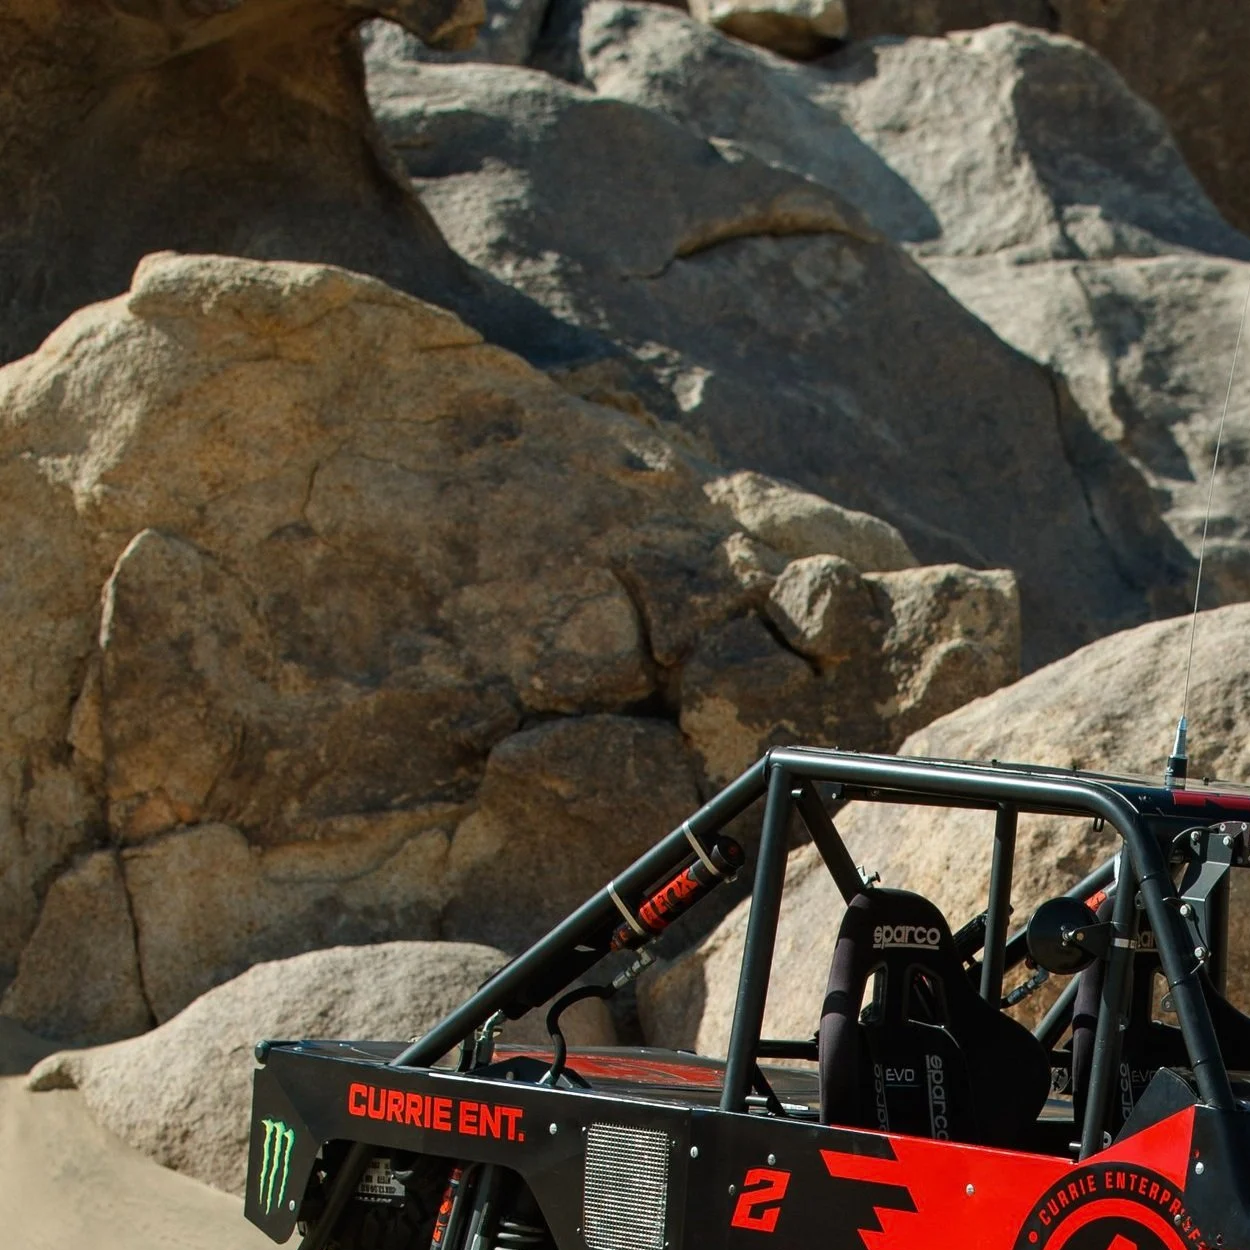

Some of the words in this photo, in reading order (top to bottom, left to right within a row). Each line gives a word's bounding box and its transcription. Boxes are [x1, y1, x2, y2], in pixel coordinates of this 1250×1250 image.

[873, 925, 941, 949] sparco
[874, 1063, 890, 1132] arco
[885, 1067, 915, 1082] EVO
[349, 1083, 452, 1132] CURRIE
[459, 1101, 526, 1142] ENT.
[731, 1168, 791, 1233] 2
[1038, 1175, 1097, 1226] CURRIE
